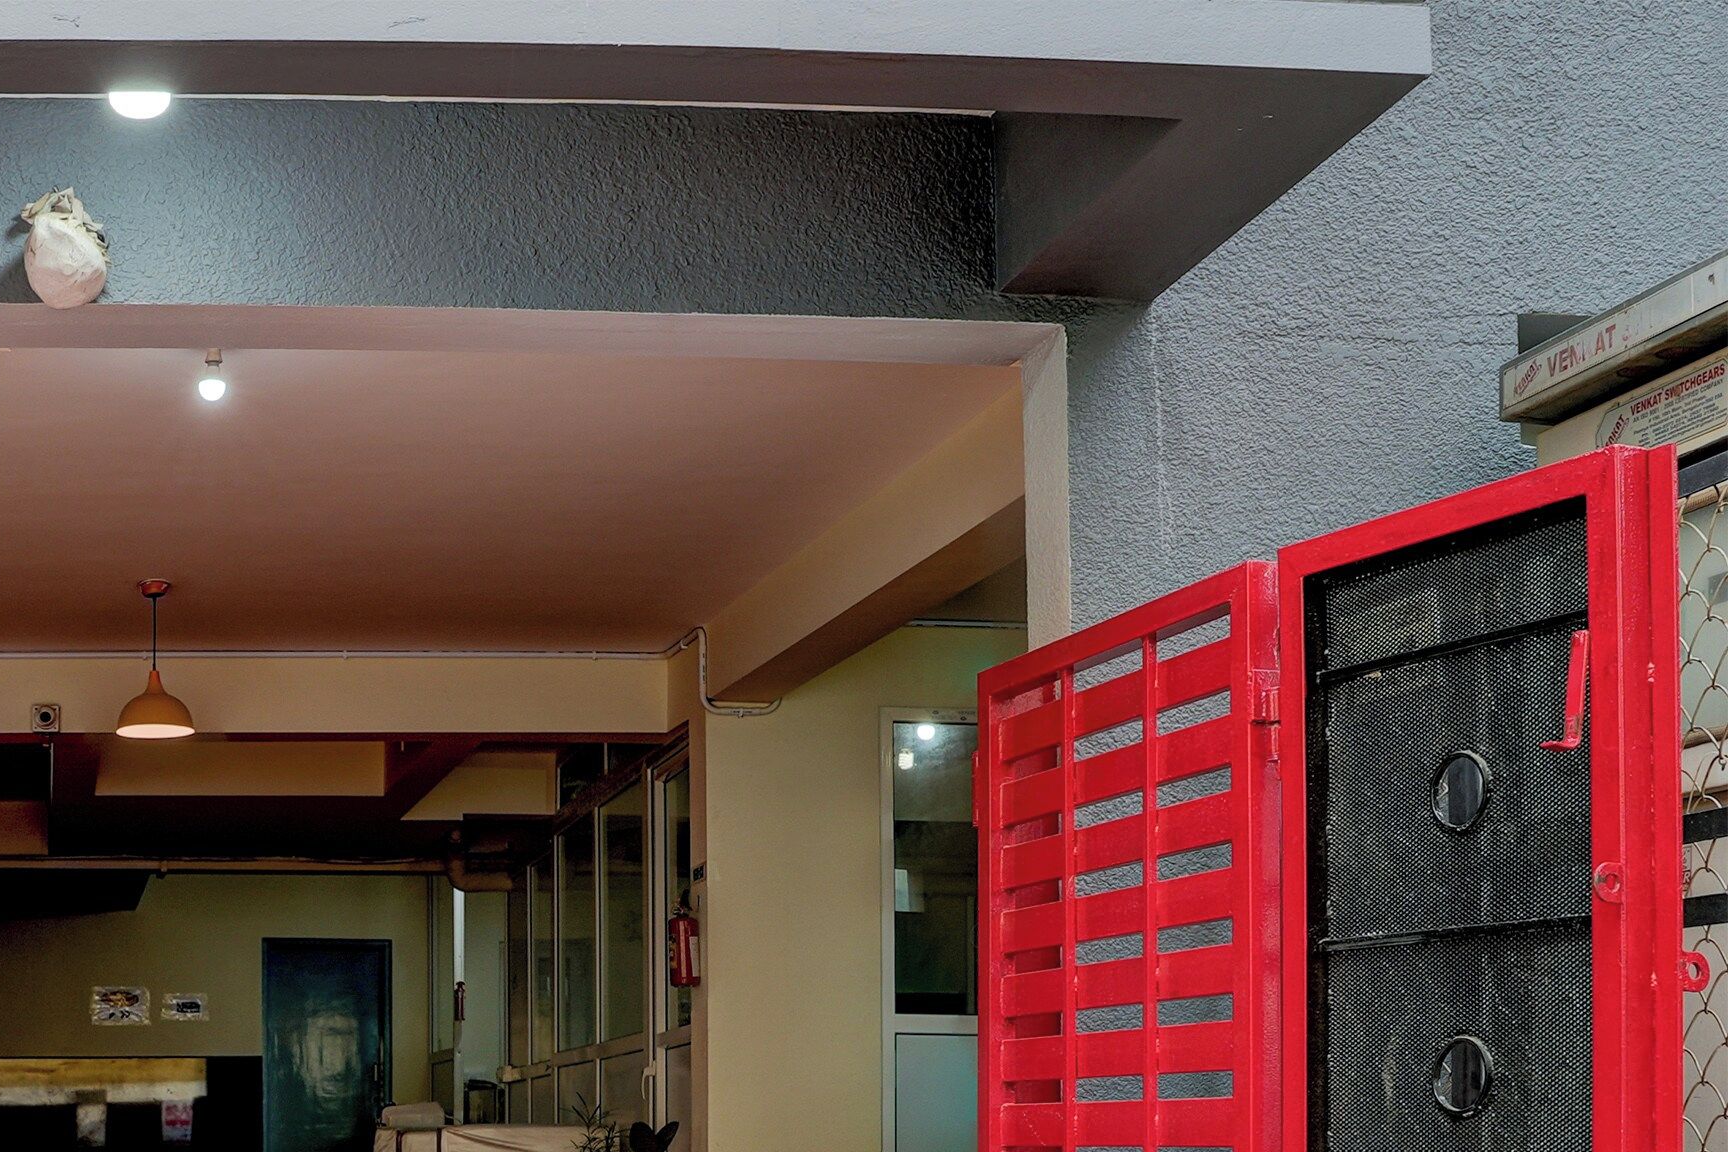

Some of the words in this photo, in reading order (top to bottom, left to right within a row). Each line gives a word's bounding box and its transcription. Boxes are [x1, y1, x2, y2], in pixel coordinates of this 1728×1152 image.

[1546, 323, 1616, 377] VENAT
[1630, 391, 1663, 415] VENKAT
[1664, 363, 1726, 401] SWTCHGEARS
